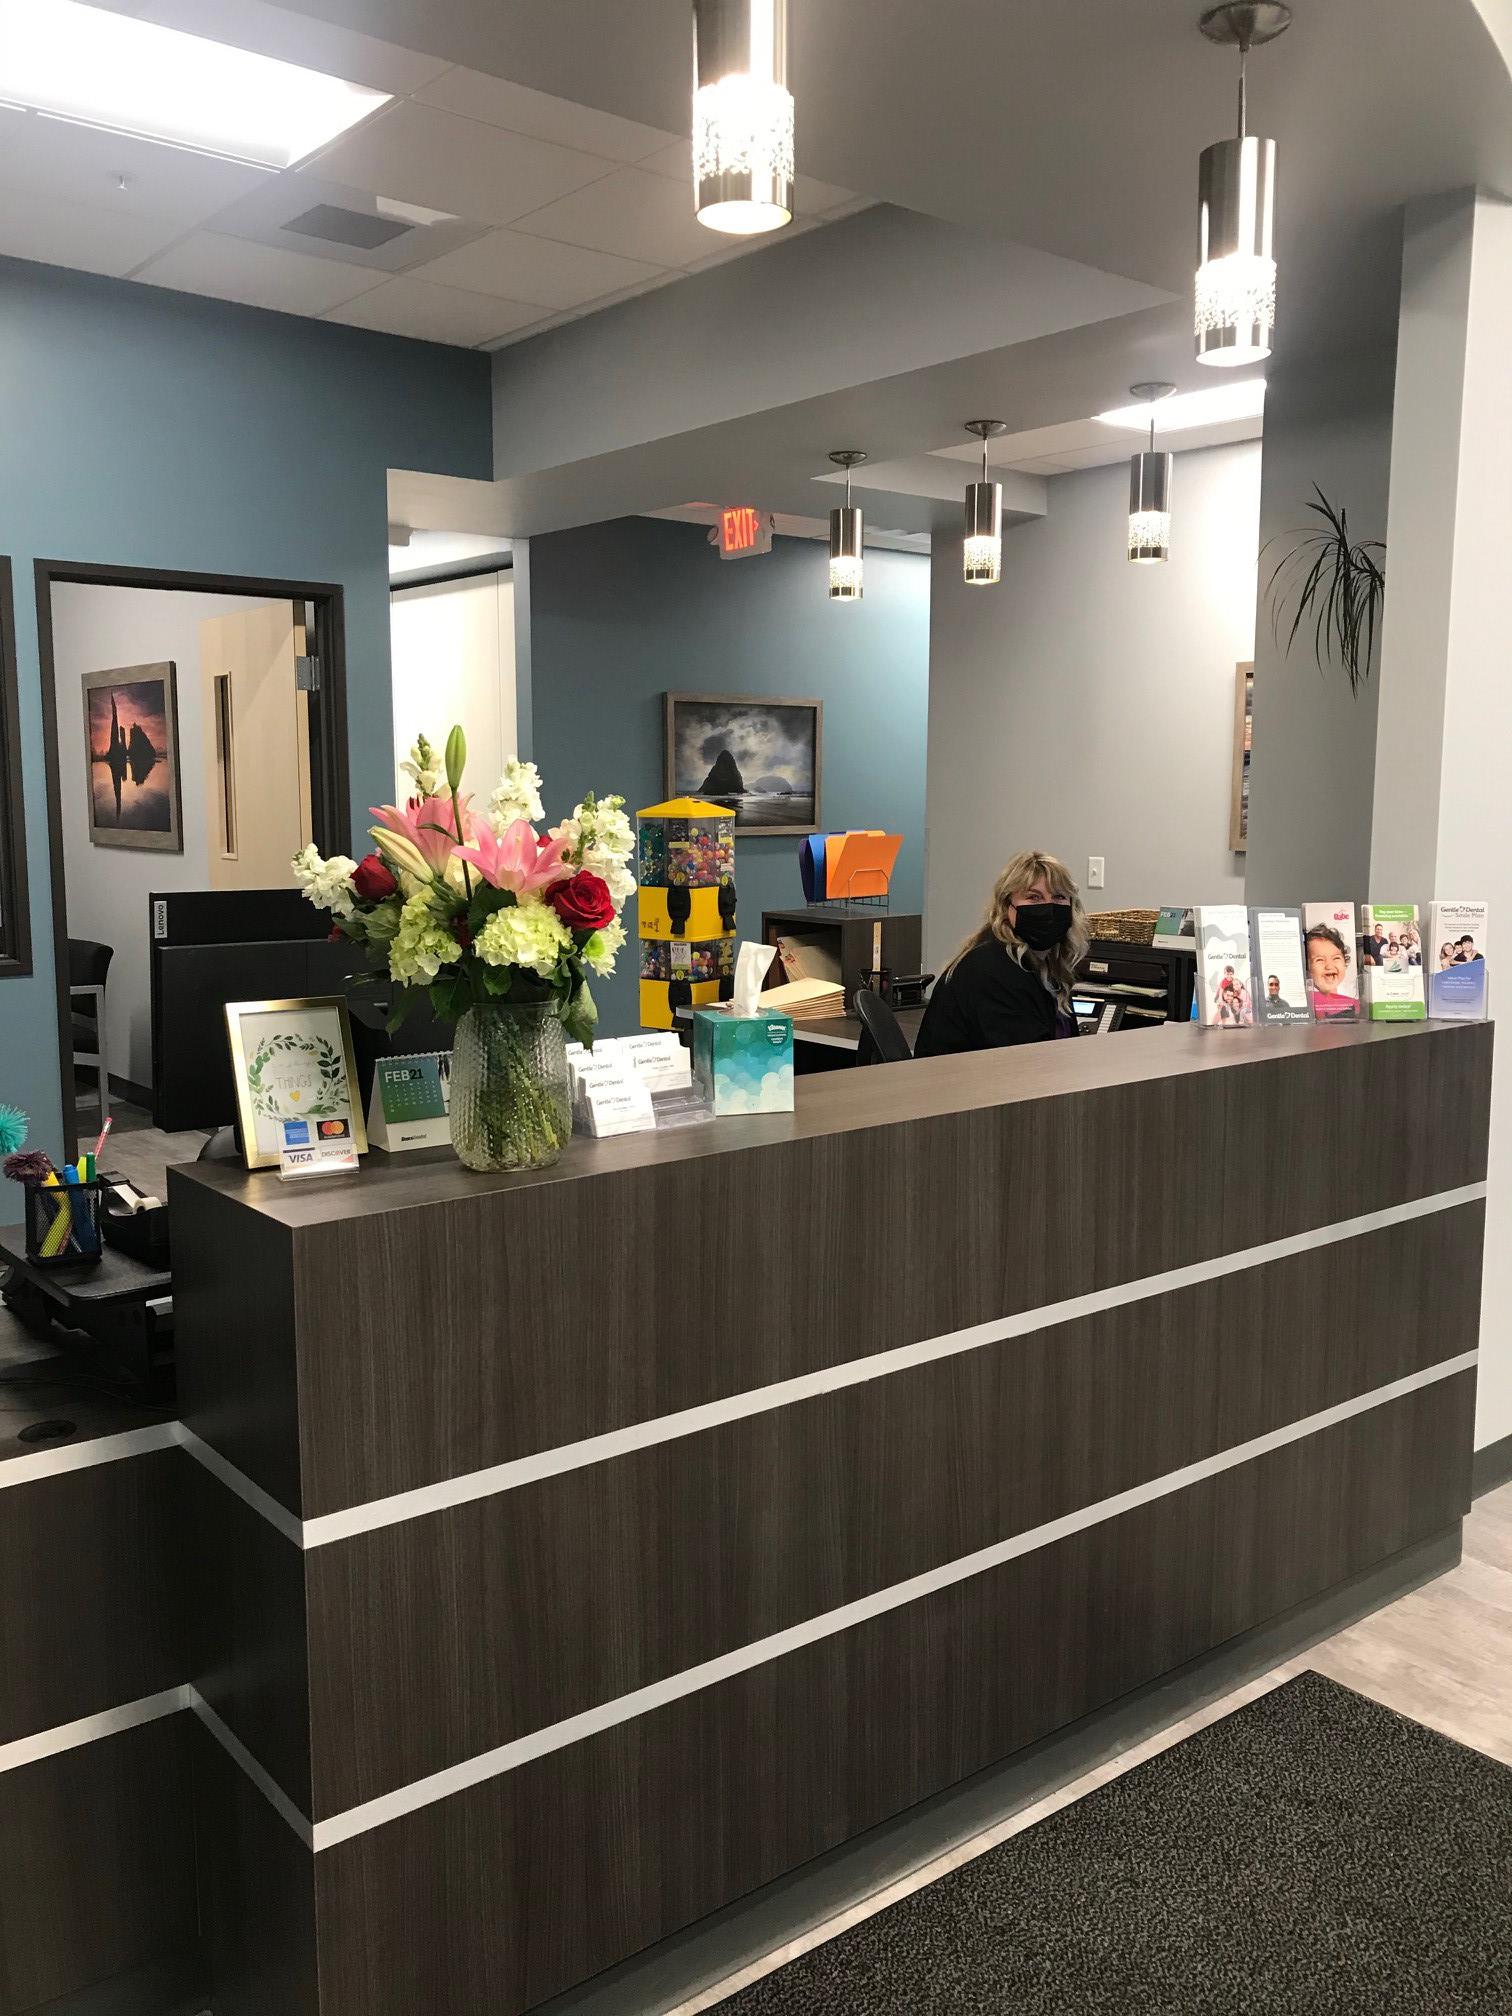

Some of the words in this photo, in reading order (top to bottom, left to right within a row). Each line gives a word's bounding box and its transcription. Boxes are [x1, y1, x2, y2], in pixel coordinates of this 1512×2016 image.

[723, 508, 755, 552] EXIT
[157, 904, 165, 936] Lenovo
[288, 1153, 314, 1164] VISA
[321, 1149, 351, 1157] DISCOVER
